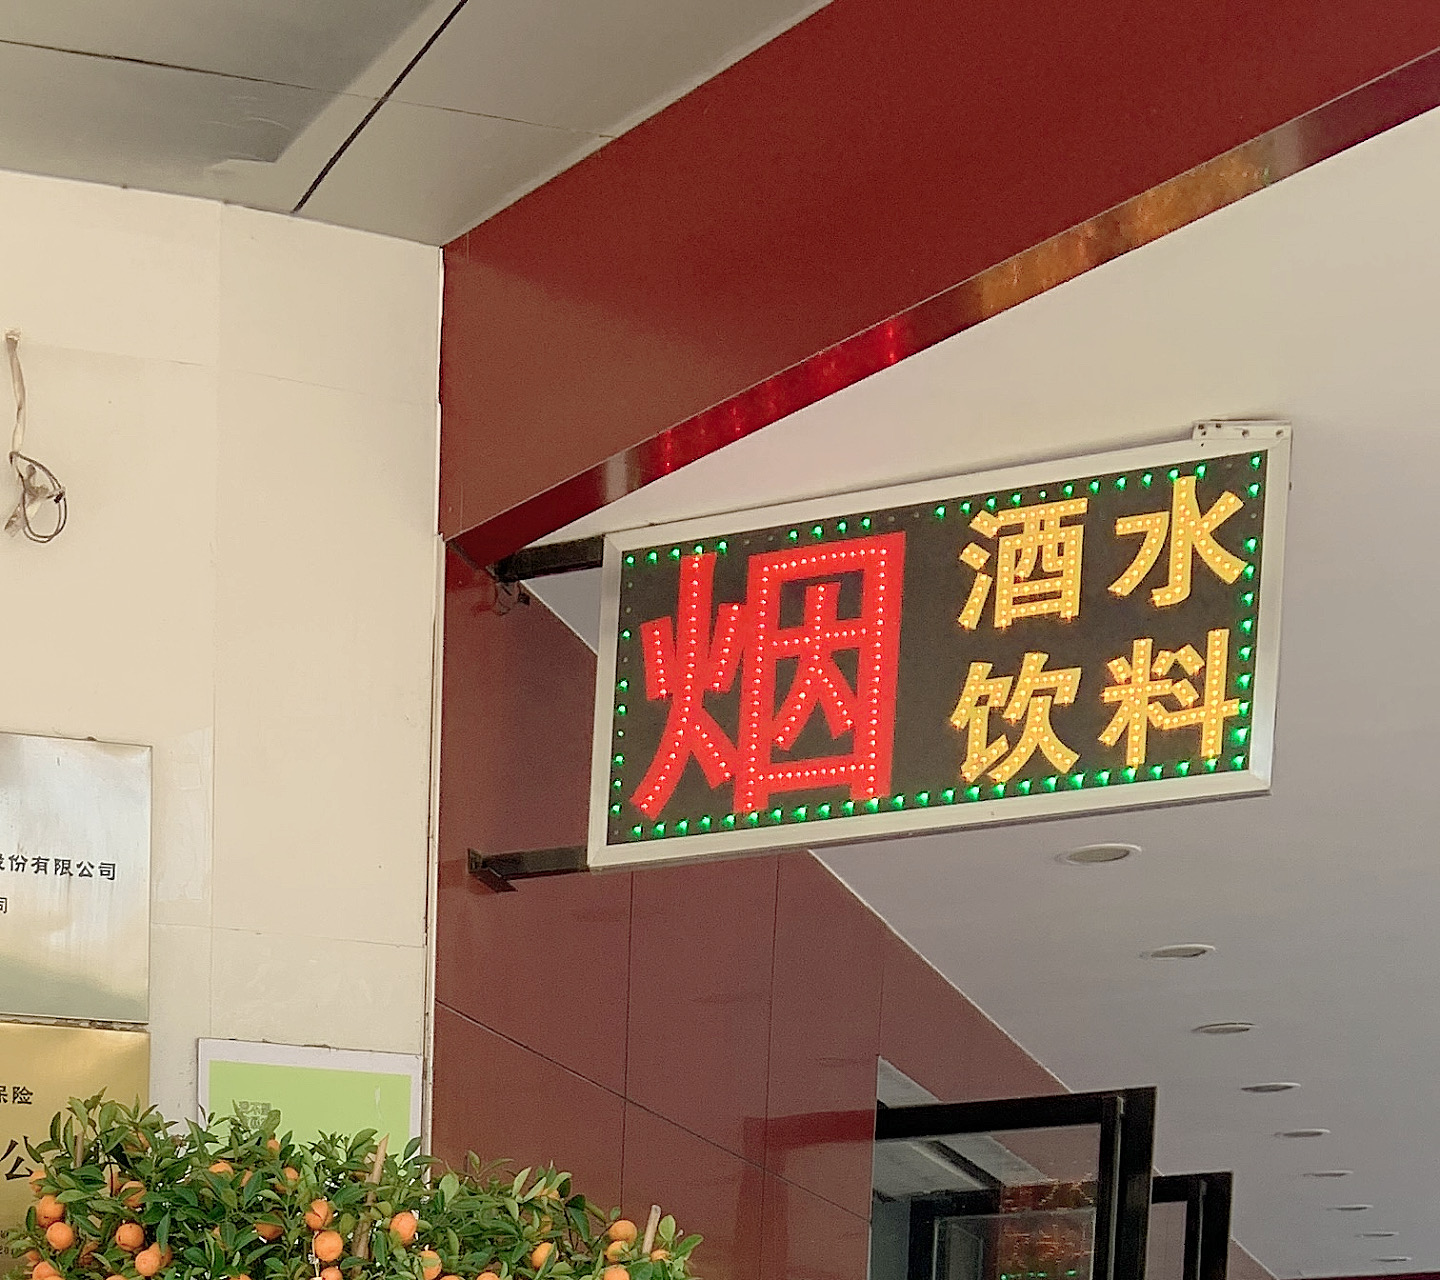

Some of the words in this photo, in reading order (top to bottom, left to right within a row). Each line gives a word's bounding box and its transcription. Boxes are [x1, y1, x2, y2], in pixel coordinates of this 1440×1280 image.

[957, 474, 1247, 631] 酒水
[630, 531, 907, 821] 烟
[951, 628, 1242, 784] 饮料
